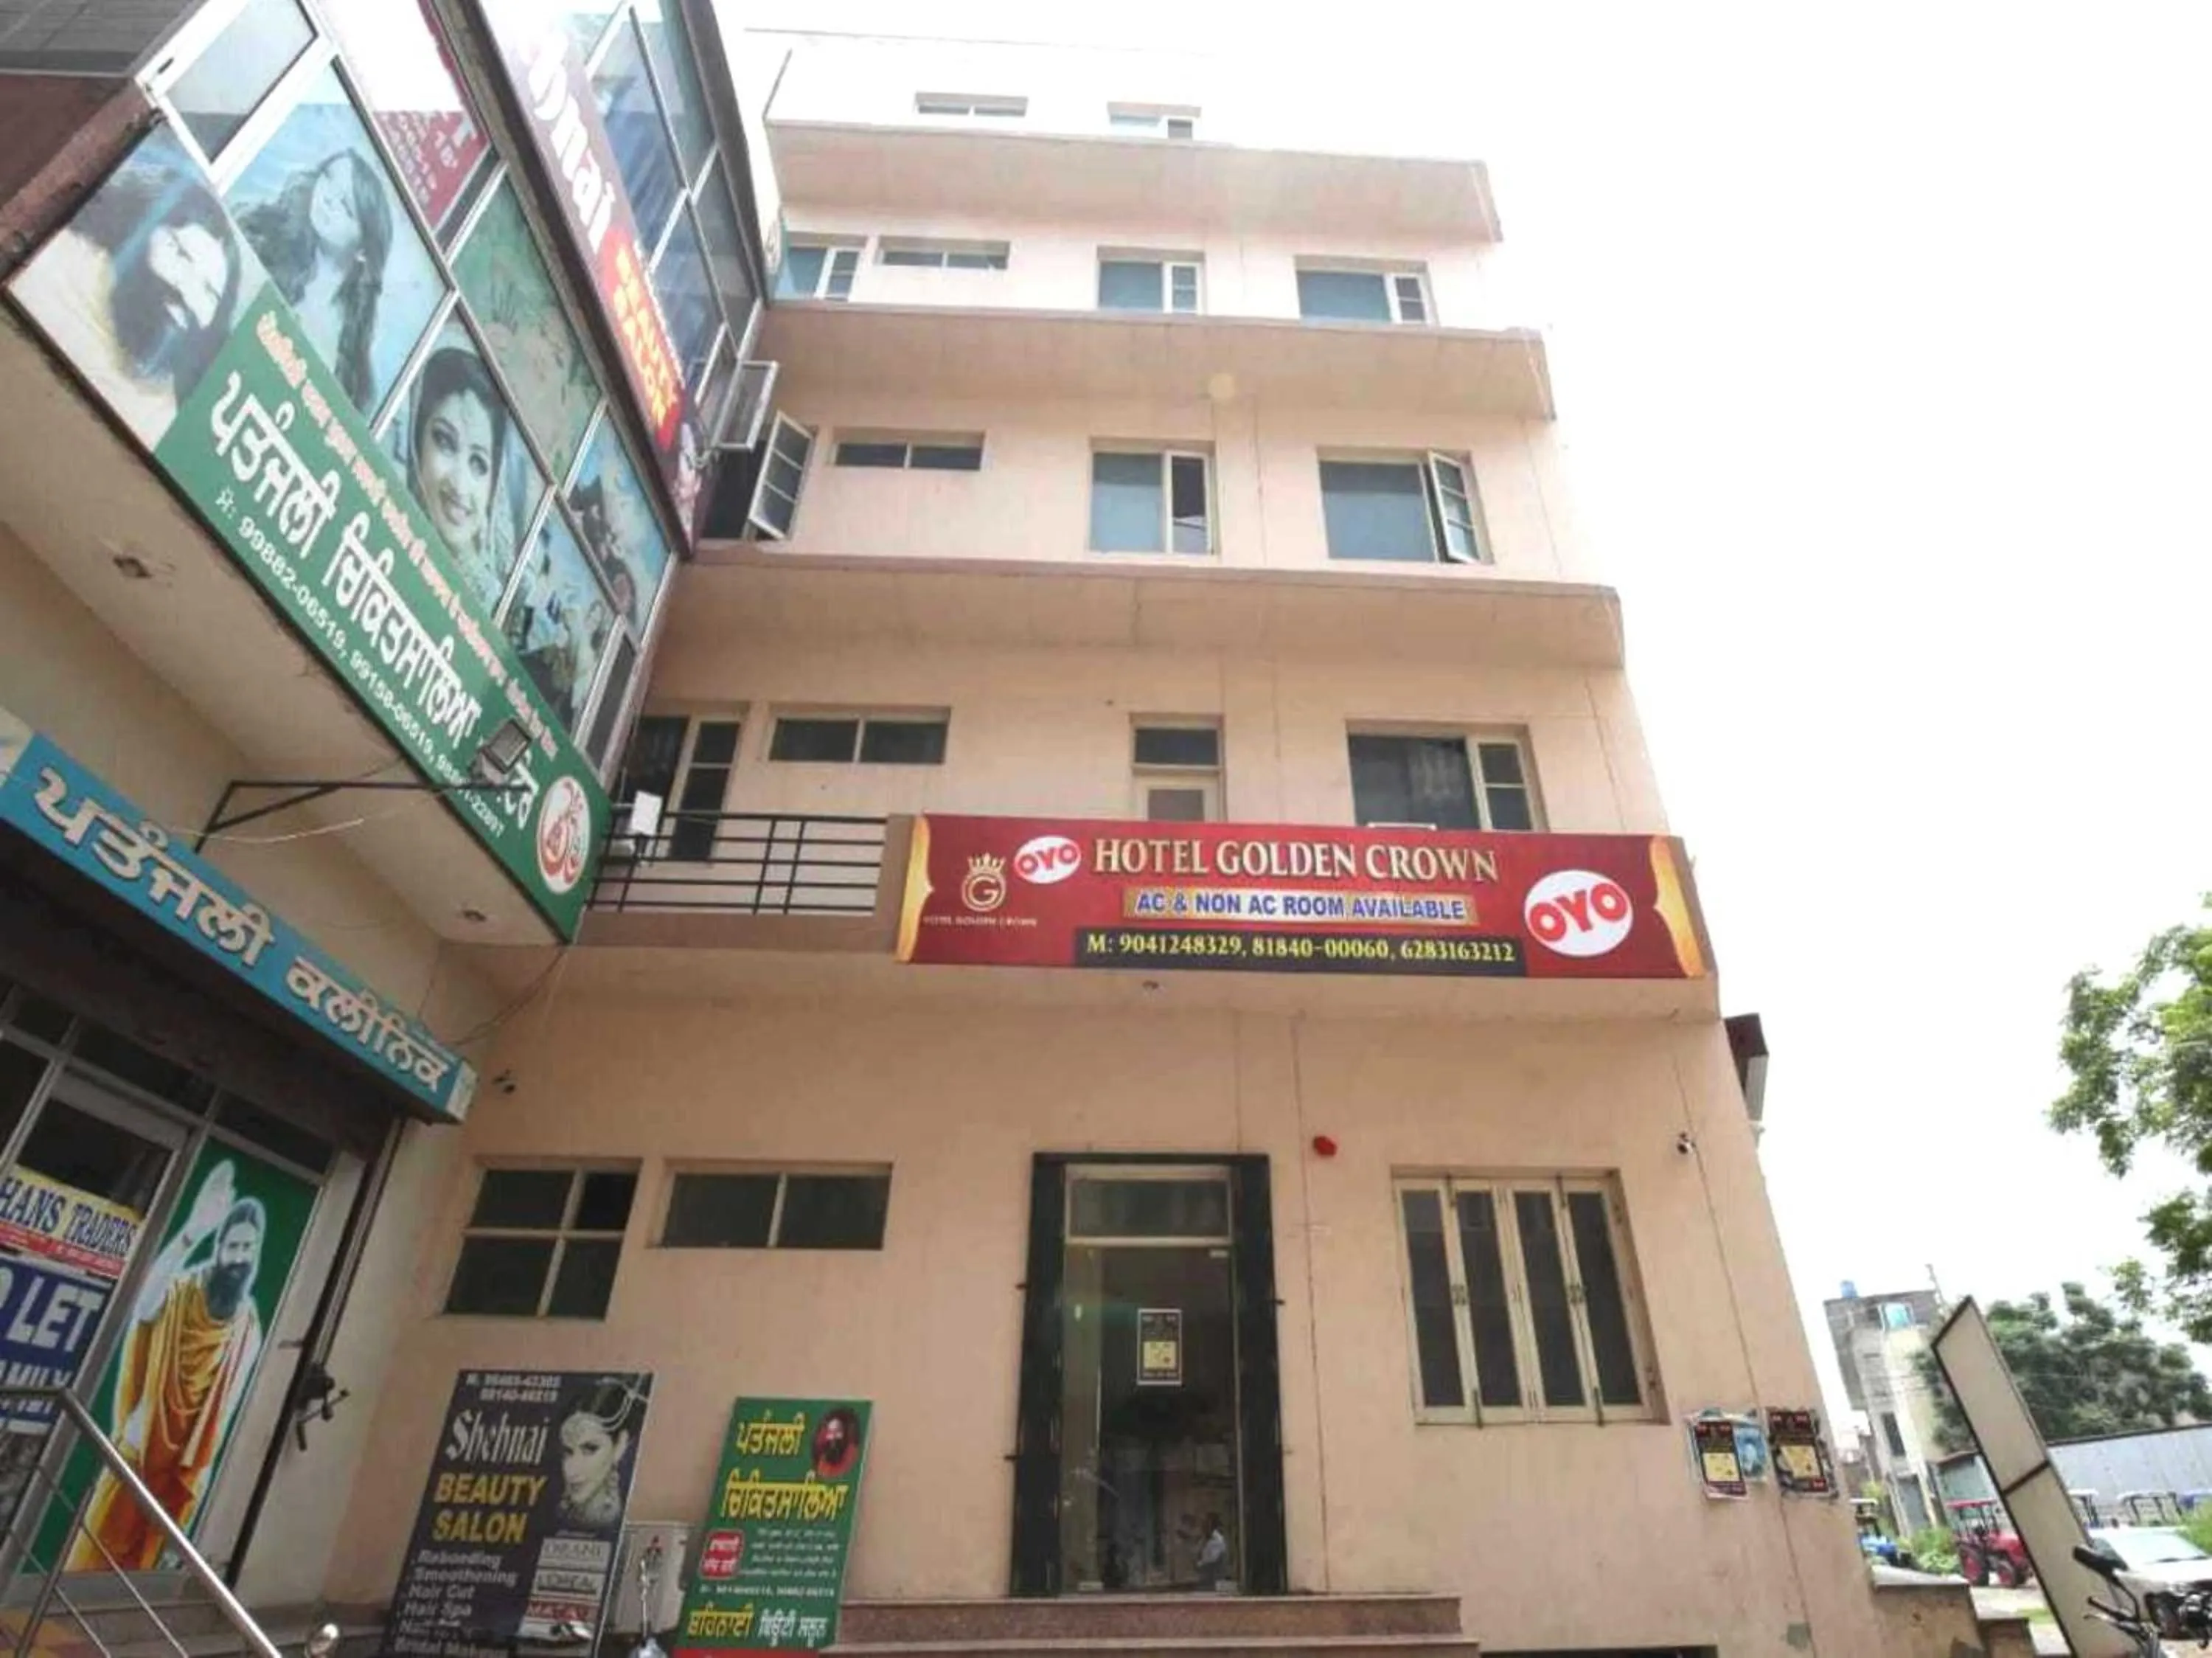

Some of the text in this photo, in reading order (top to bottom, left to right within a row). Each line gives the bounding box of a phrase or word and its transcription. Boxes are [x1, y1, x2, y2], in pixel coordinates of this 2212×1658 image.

[211, 370, 340, 558] ਪਤੰਜਲੀ
[1015, 841, 1080, 879] OYO
[1093, 838, 1498, 883] HOTEL GOLDEN CROWN
[1136, 892, 1464, 920] AC & NON AC ROOM AVAILABLE
[1528, 882, 1630, 942] OYO
[34, 767, 448, 1092] ਪਤੰਜਲੀ ਕਲੀਨਿਕ
[1087, 932, 1515, 962] M: 9041248329, 81840-00060, 6283163212
[8, 1275, 105, 1353] LET
[445, 1409, 552, 1466] Shehnai
[434, 1473, 547, 1507] BEAUTY
[431, 1510, 528, 1544] SALON
